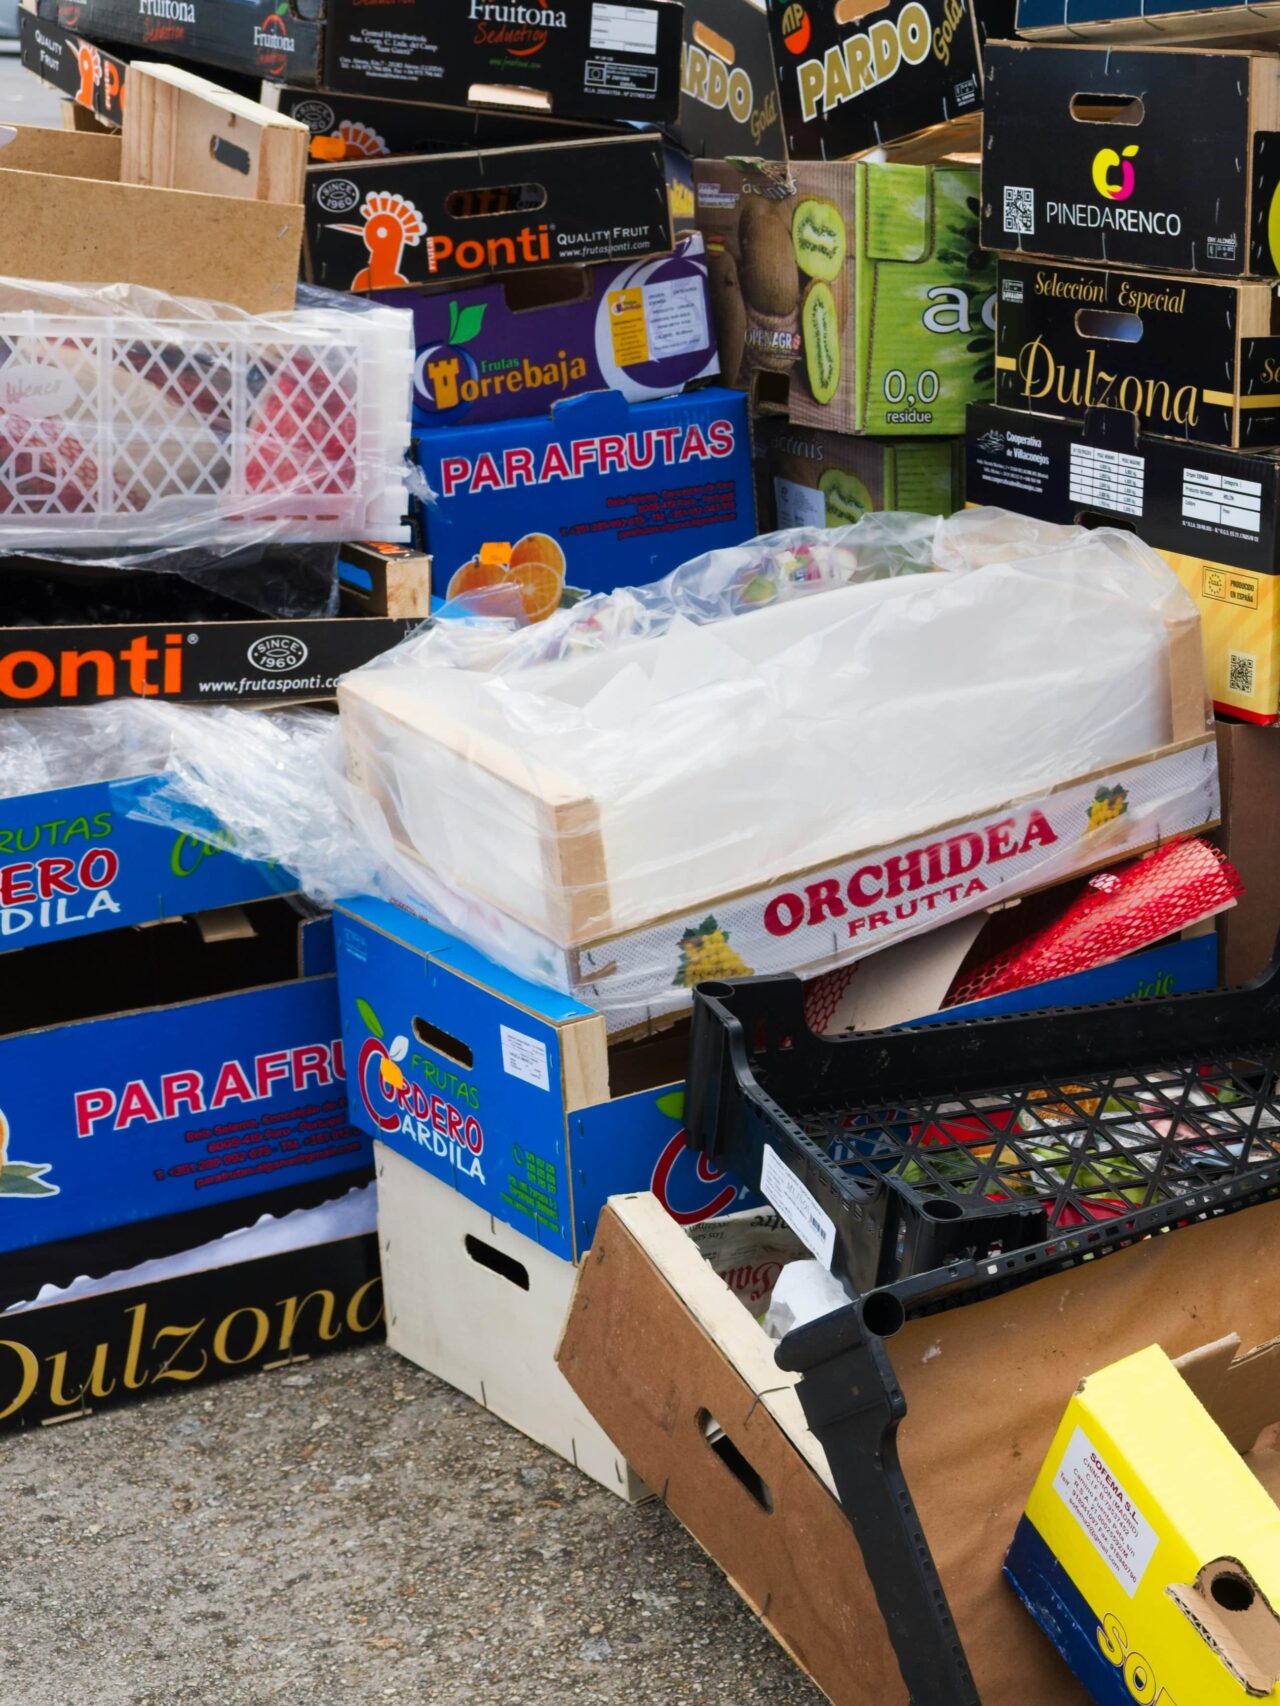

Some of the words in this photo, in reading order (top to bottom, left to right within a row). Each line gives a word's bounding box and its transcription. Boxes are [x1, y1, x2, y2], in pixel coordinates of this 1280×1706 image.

[468, 0, 567, 28] Fruitona
[34, 29, 63, 56] QUALITY
[253, 26, 295, 52] Fruitona
[474, 22, 549, 46] Seduction
[933, 0, 964, 66] Gold
[40, 50, 60, 72] FRUIT
[797, 2, 931, 122] PARDO
[680, 42, 753, 123] ARDO
[750, 89, 777, 147] Gold
[322, 182, 355, 200] SINCE
[325, 197, 355, 210] 1960
[557, 231, 611, 246] QUALITY
[613, 225, 650, 239] FRUIT
[1046, 201, 1182, 237] PINEDARENCO
[430, 225, 550, 273] Ponti
[559, 239, 651, 259] www.frutasponti.com
[1034, 271, 1104, 303] Selección
[1118, 282, 1186, 315] Especial
[481, 357, 521, 372] Frutas
[1018, 335, 1199, 427] Dulzona
[884, 369, 940, 407] 0,0
[886, 410, 933, 424] residue
[1006, 431, 1042, 449] Cooperativa
[1013, 447, 1050, 467] Villaconejos
[441, 419, 736, 499] PARAFRUTAS
[257, 637, 301, 654] SINCE
[257, 652, 299, 670] 1960
[762, 810, 1059, 938] ORCHIDEA
[848, 876, 990, 939] FRUTTA
[411, 1053, 480, 1111] FRUTAS
[1074, 1468, 1092, 1497] Camino
[1094, 1497, 1111, 1523] Fuente
[1083, 1456, 1111, 1499] CHINCHÓN
[1113, 1498, 1138, 1537] (MADRID)
[1090, 1452, 1123, 1501] SOFEMA
[1125, 1500, 1139, 1524] S.L.
[1096, 1612, 1176, 1706] SO
